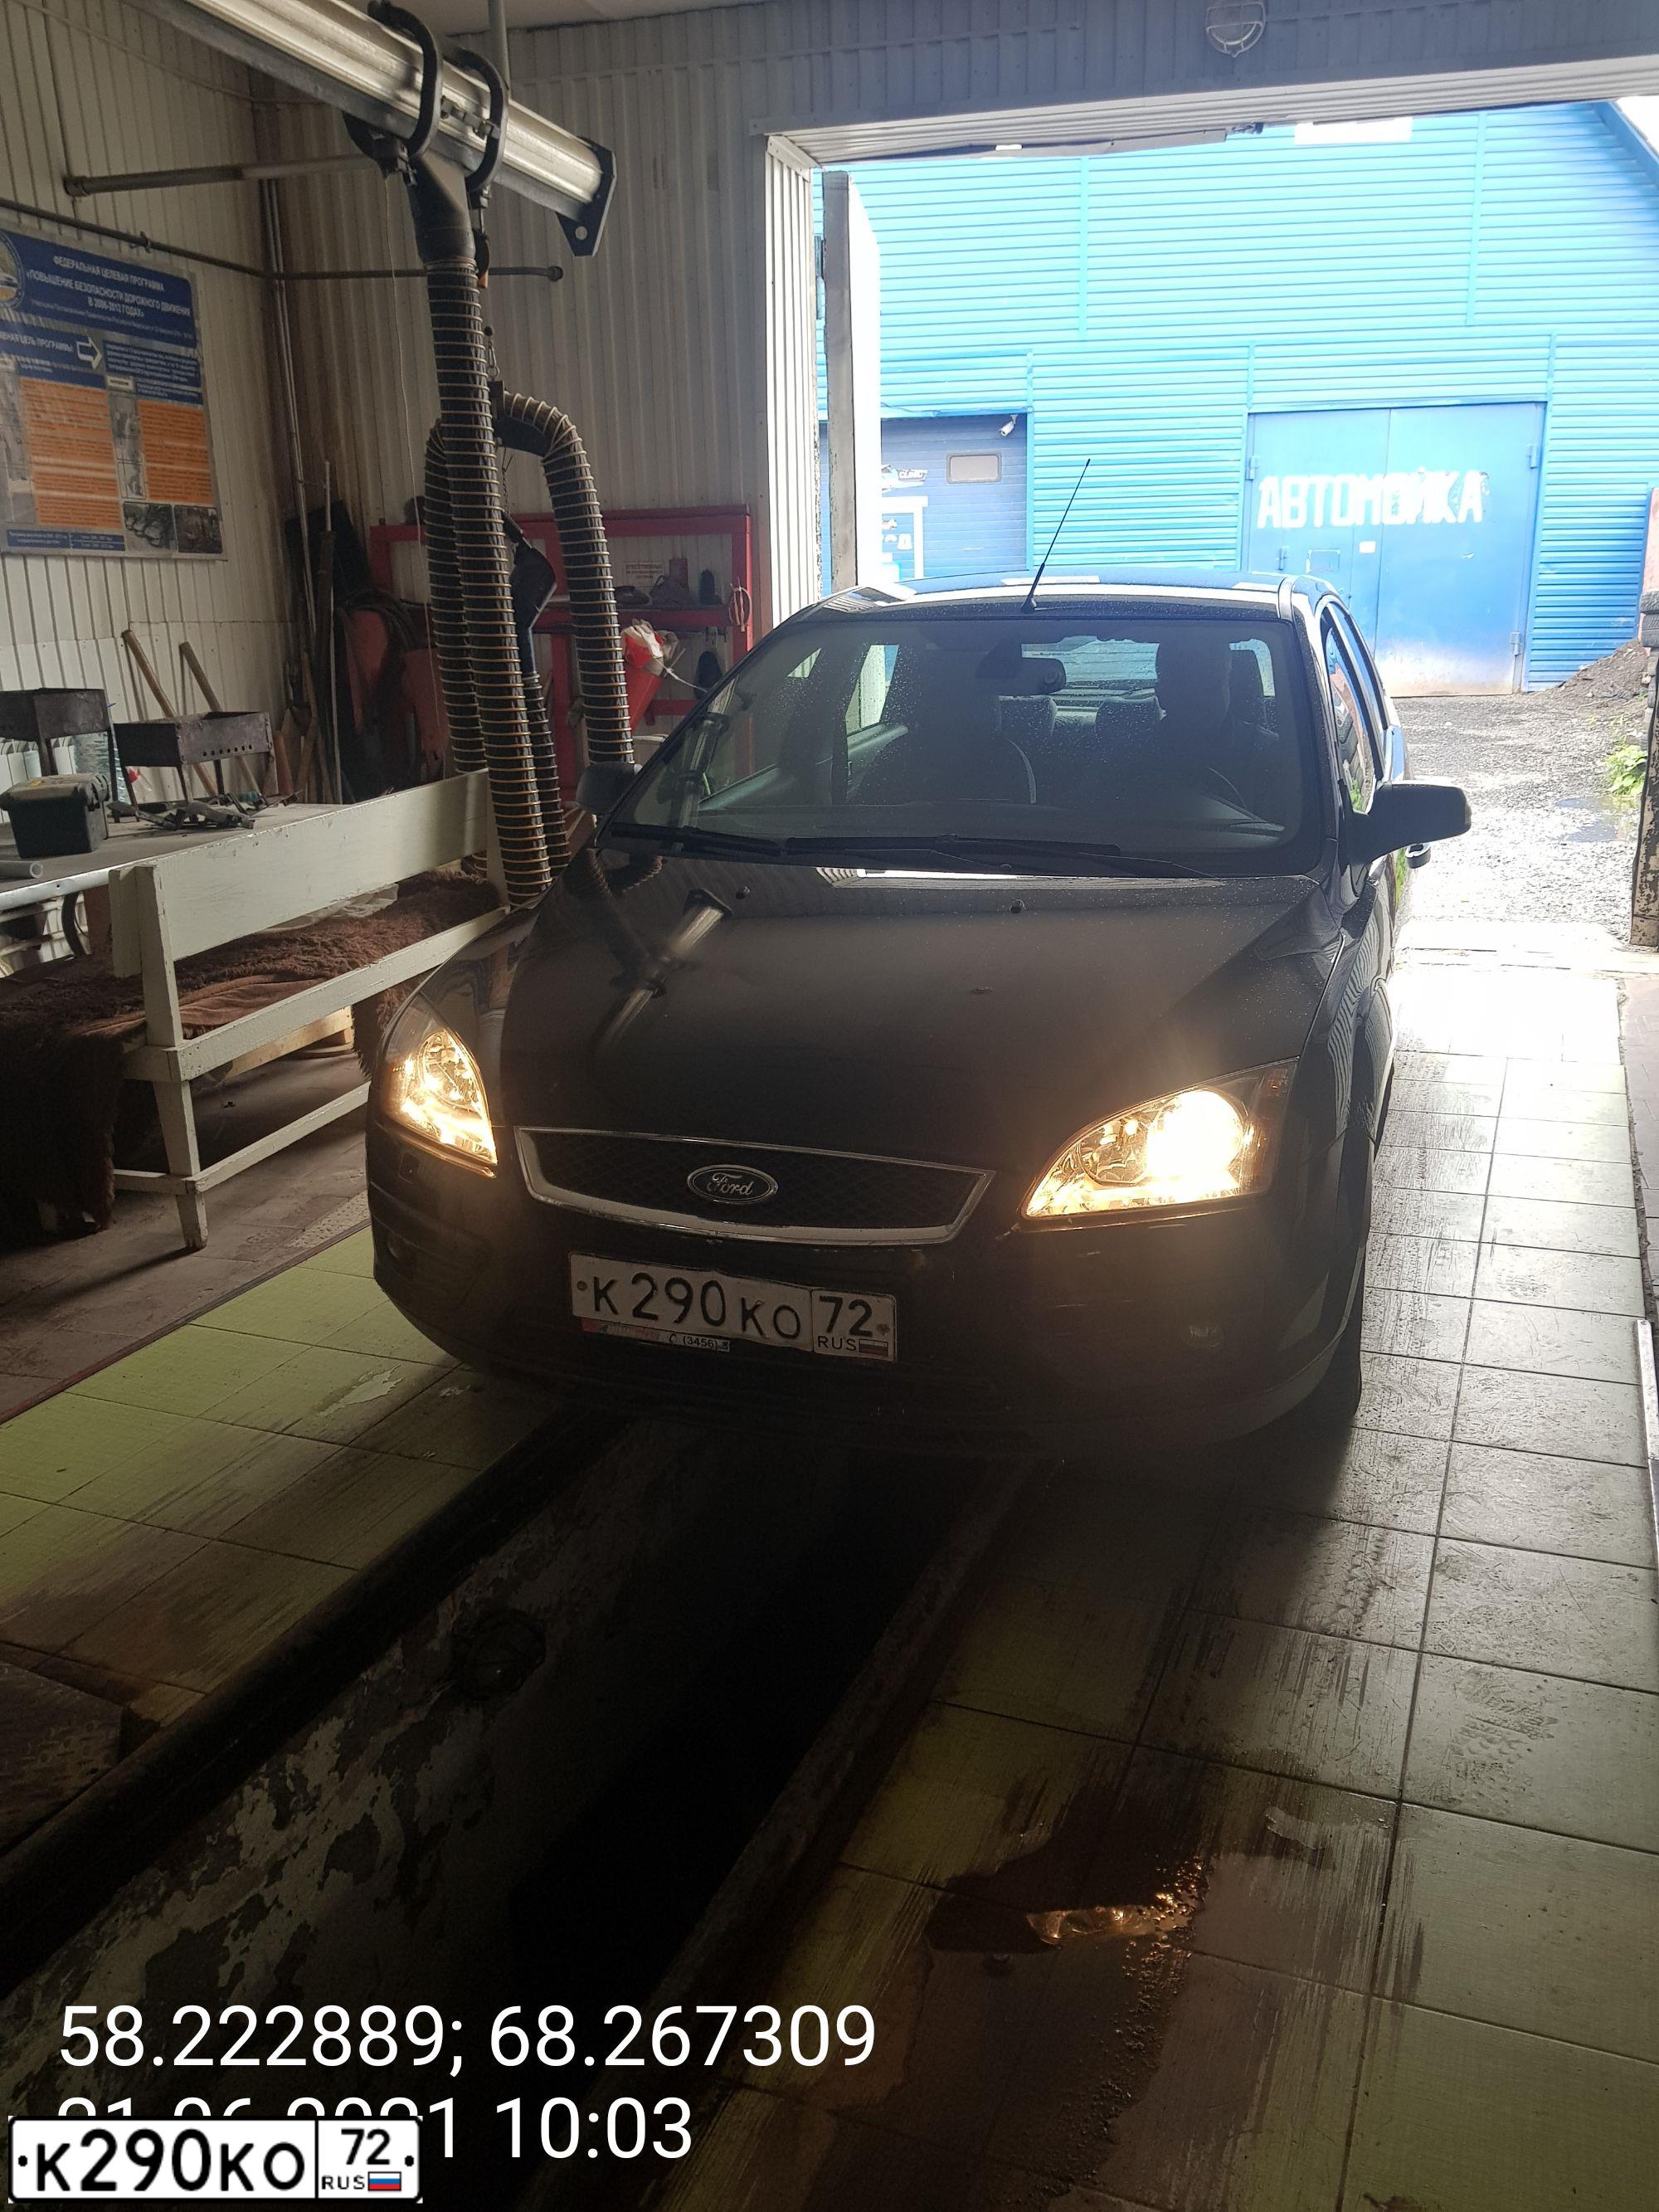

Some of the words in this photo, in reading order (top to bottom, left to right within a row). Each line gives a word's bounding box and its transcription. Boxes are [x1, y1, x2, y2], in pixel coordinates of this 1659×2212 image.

[1257, 469, 1484, 529] АВТОМОЙКА
[707, 1172, 754, 1196] Ford
[819, 1295, 874, 1337] 72
[683, 1336, 718, 1349] (3456)
[817, 1334, 857, 1352] RUS
